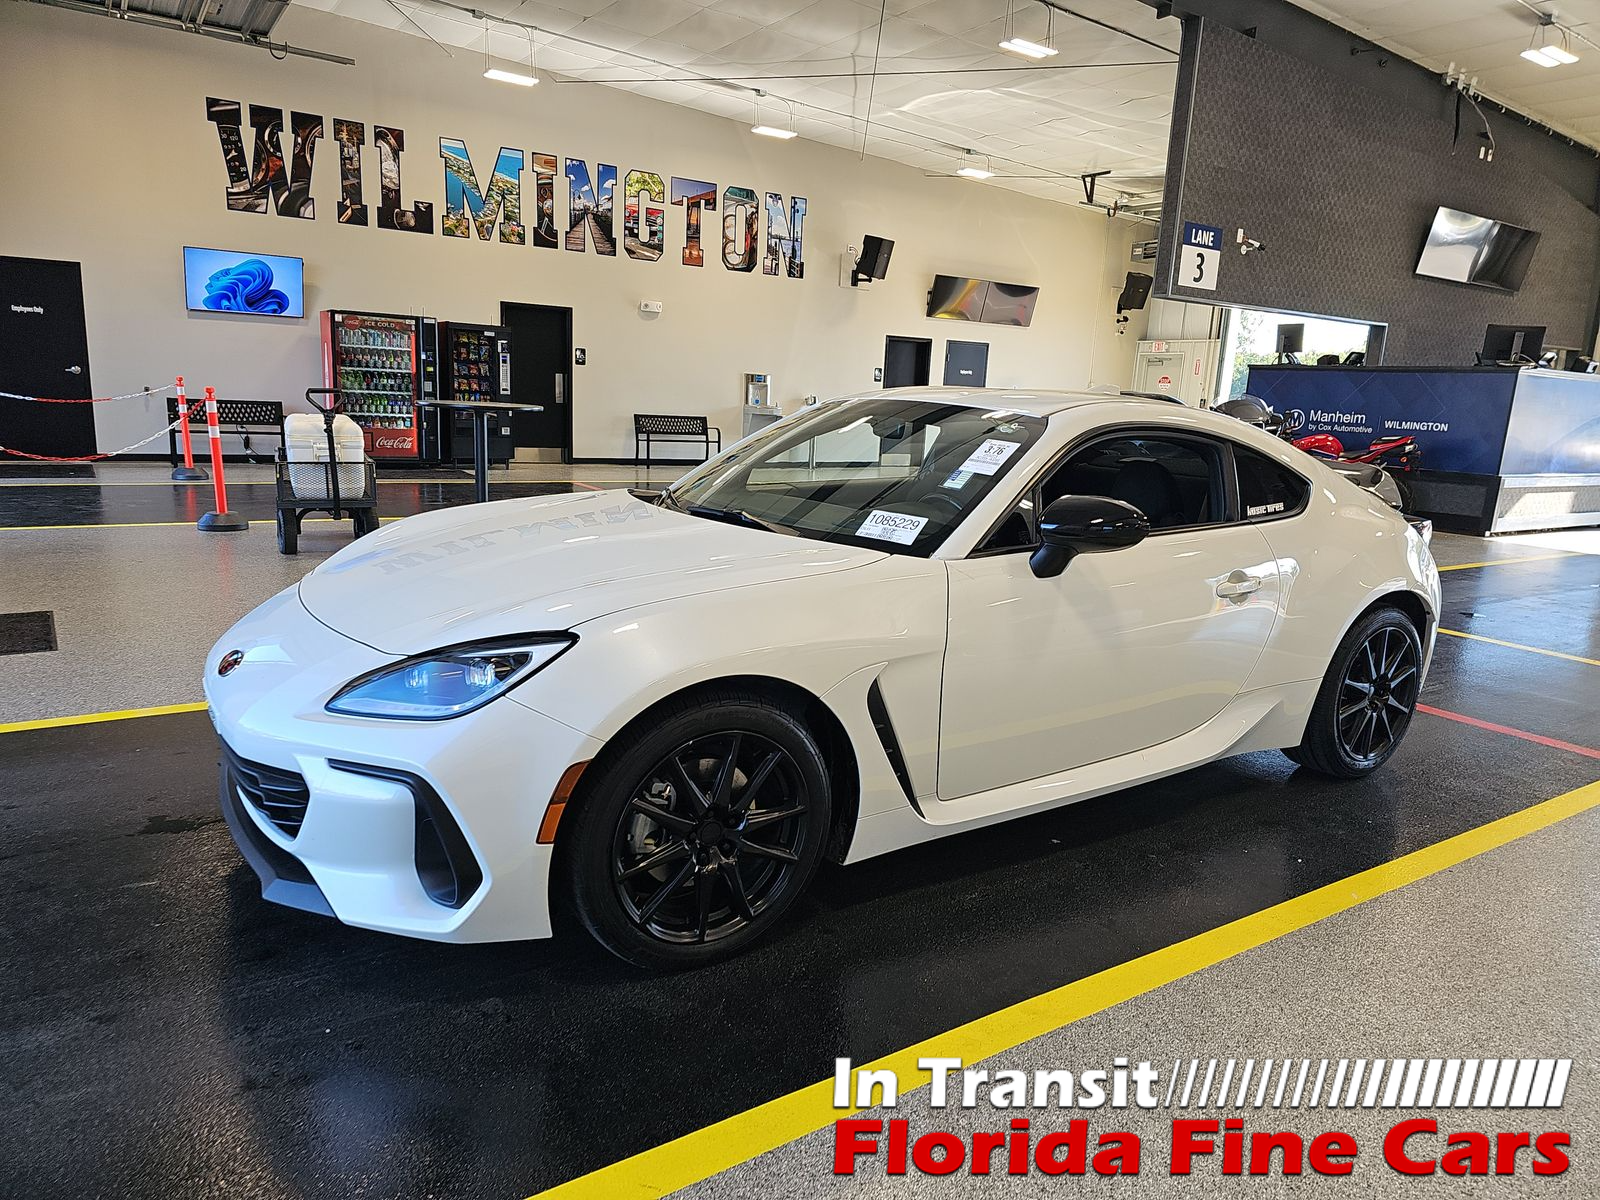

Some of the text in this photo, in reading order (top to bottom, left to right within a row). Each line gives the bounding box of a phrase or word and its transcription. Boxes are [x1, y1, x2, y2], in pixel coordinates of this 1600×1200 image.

[205, 96, 808, 279] WILMINGTON
[1191, 228, 1215, 246] LANE
[1192, 252, 1205, 283] 3
[1309, 409, 1366, 424] Manheim
[1308, 423, 1317, 431] by
[1333, 424, 1373, 434] Automotive
[1384, 420, 1449, 432] WILMINGTON
[869, 513, 921, 531] 1085229
